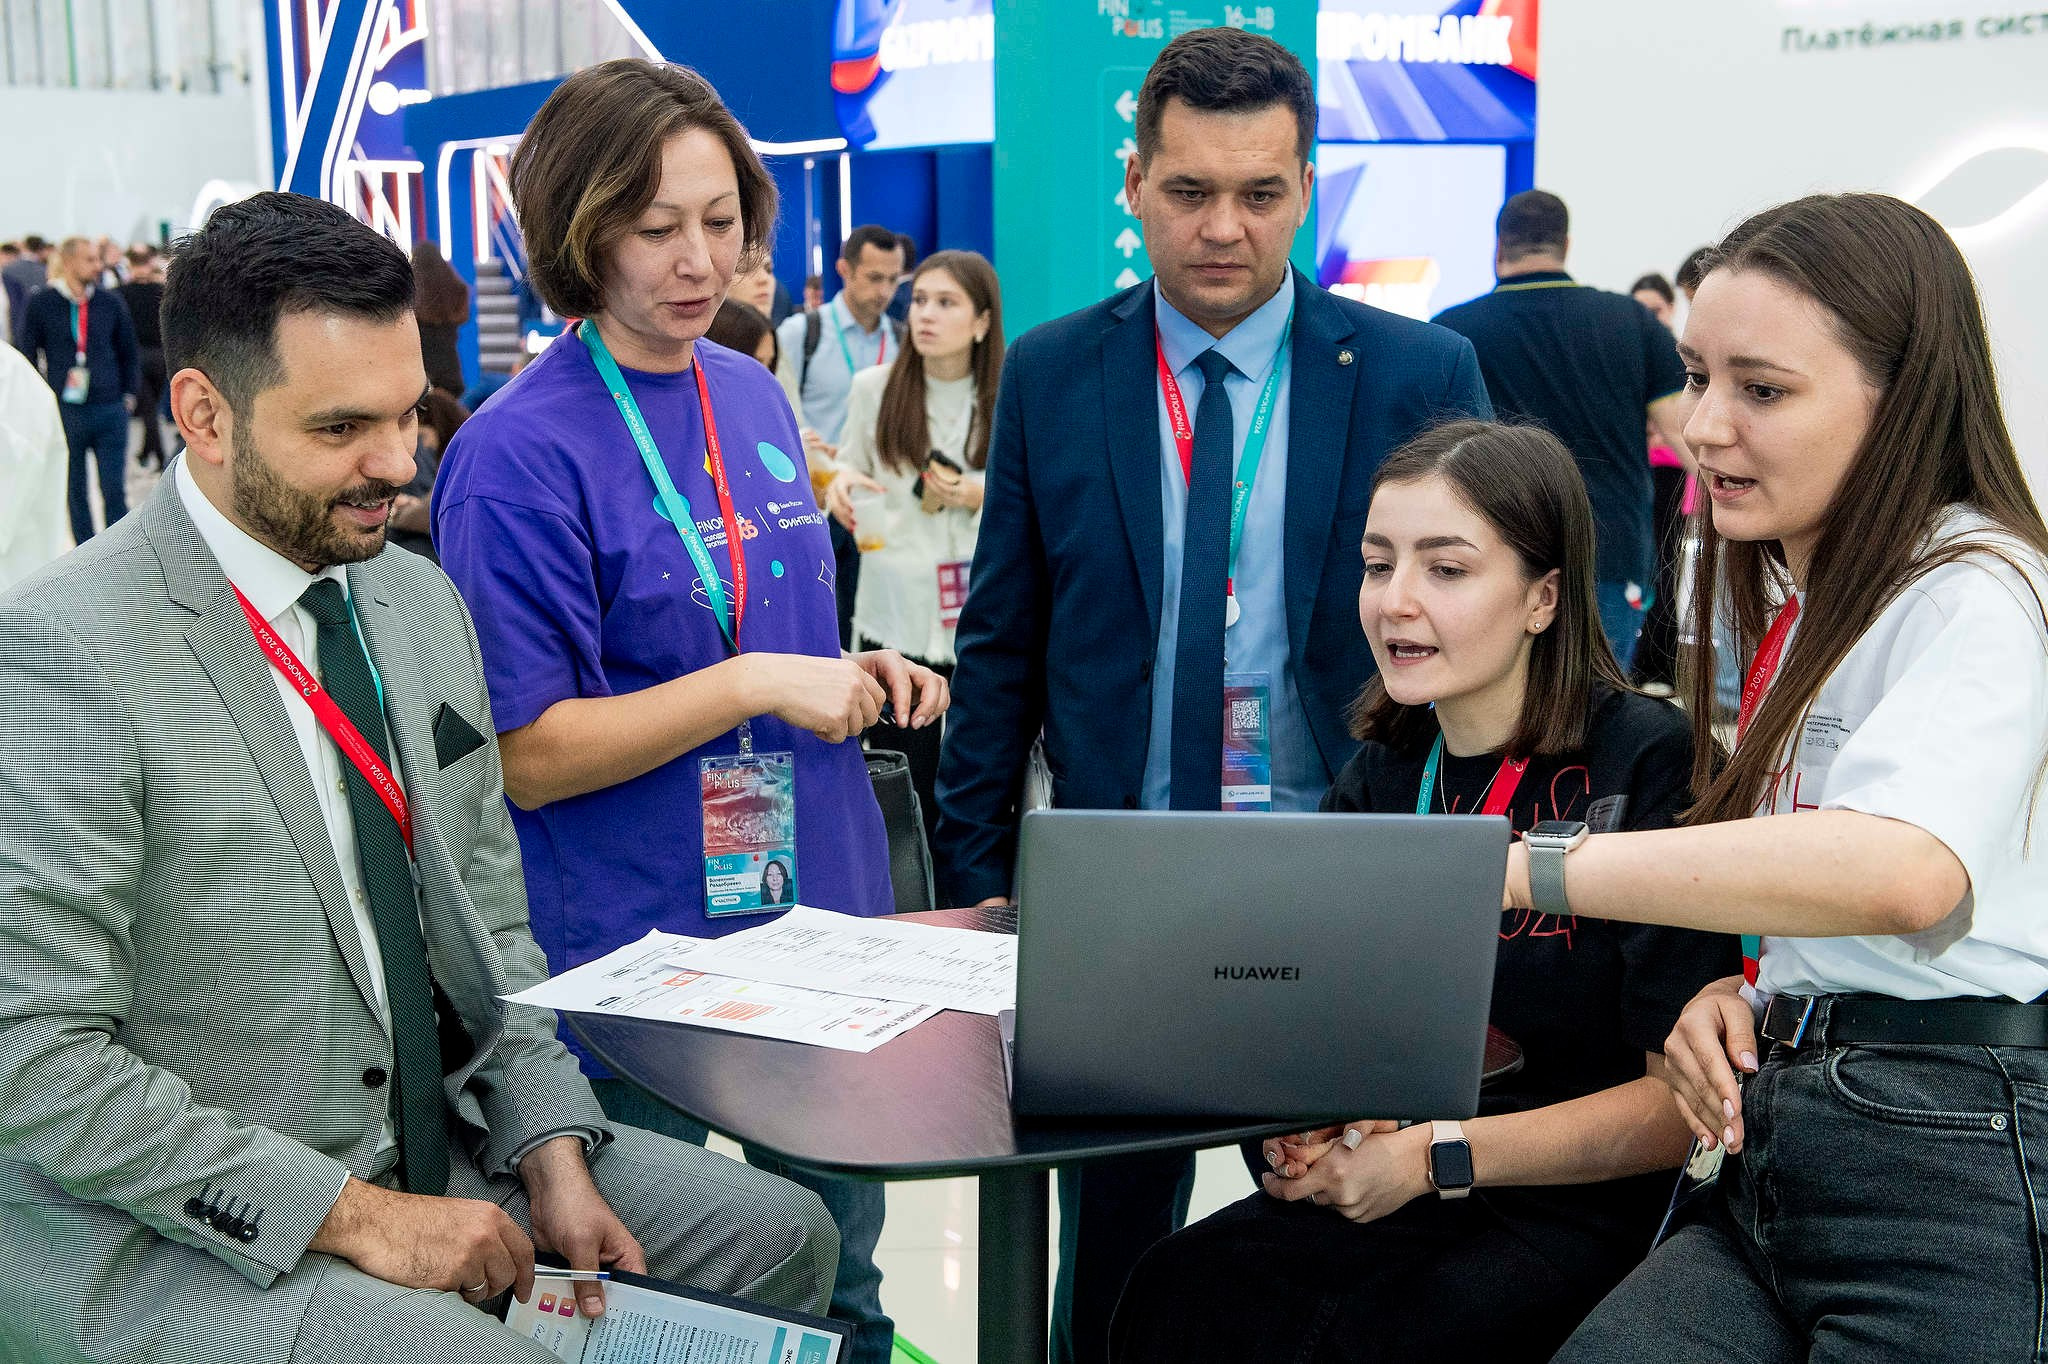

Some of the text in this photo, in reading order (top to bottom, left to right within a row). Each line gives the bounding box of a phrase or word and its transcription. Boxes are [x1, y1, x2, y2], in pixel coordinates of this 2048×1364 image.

[689, 534, 711, 572] FINOPOLIS
[258, 627, 309, 688] FINOPOLIS 2024
[1751, 667, 1767, 691] 2024
[368, 763, 387, 784] 2024
[707, 773, 722, 782] FIN
[1214, 966, 1300, 981] HUAWEI
